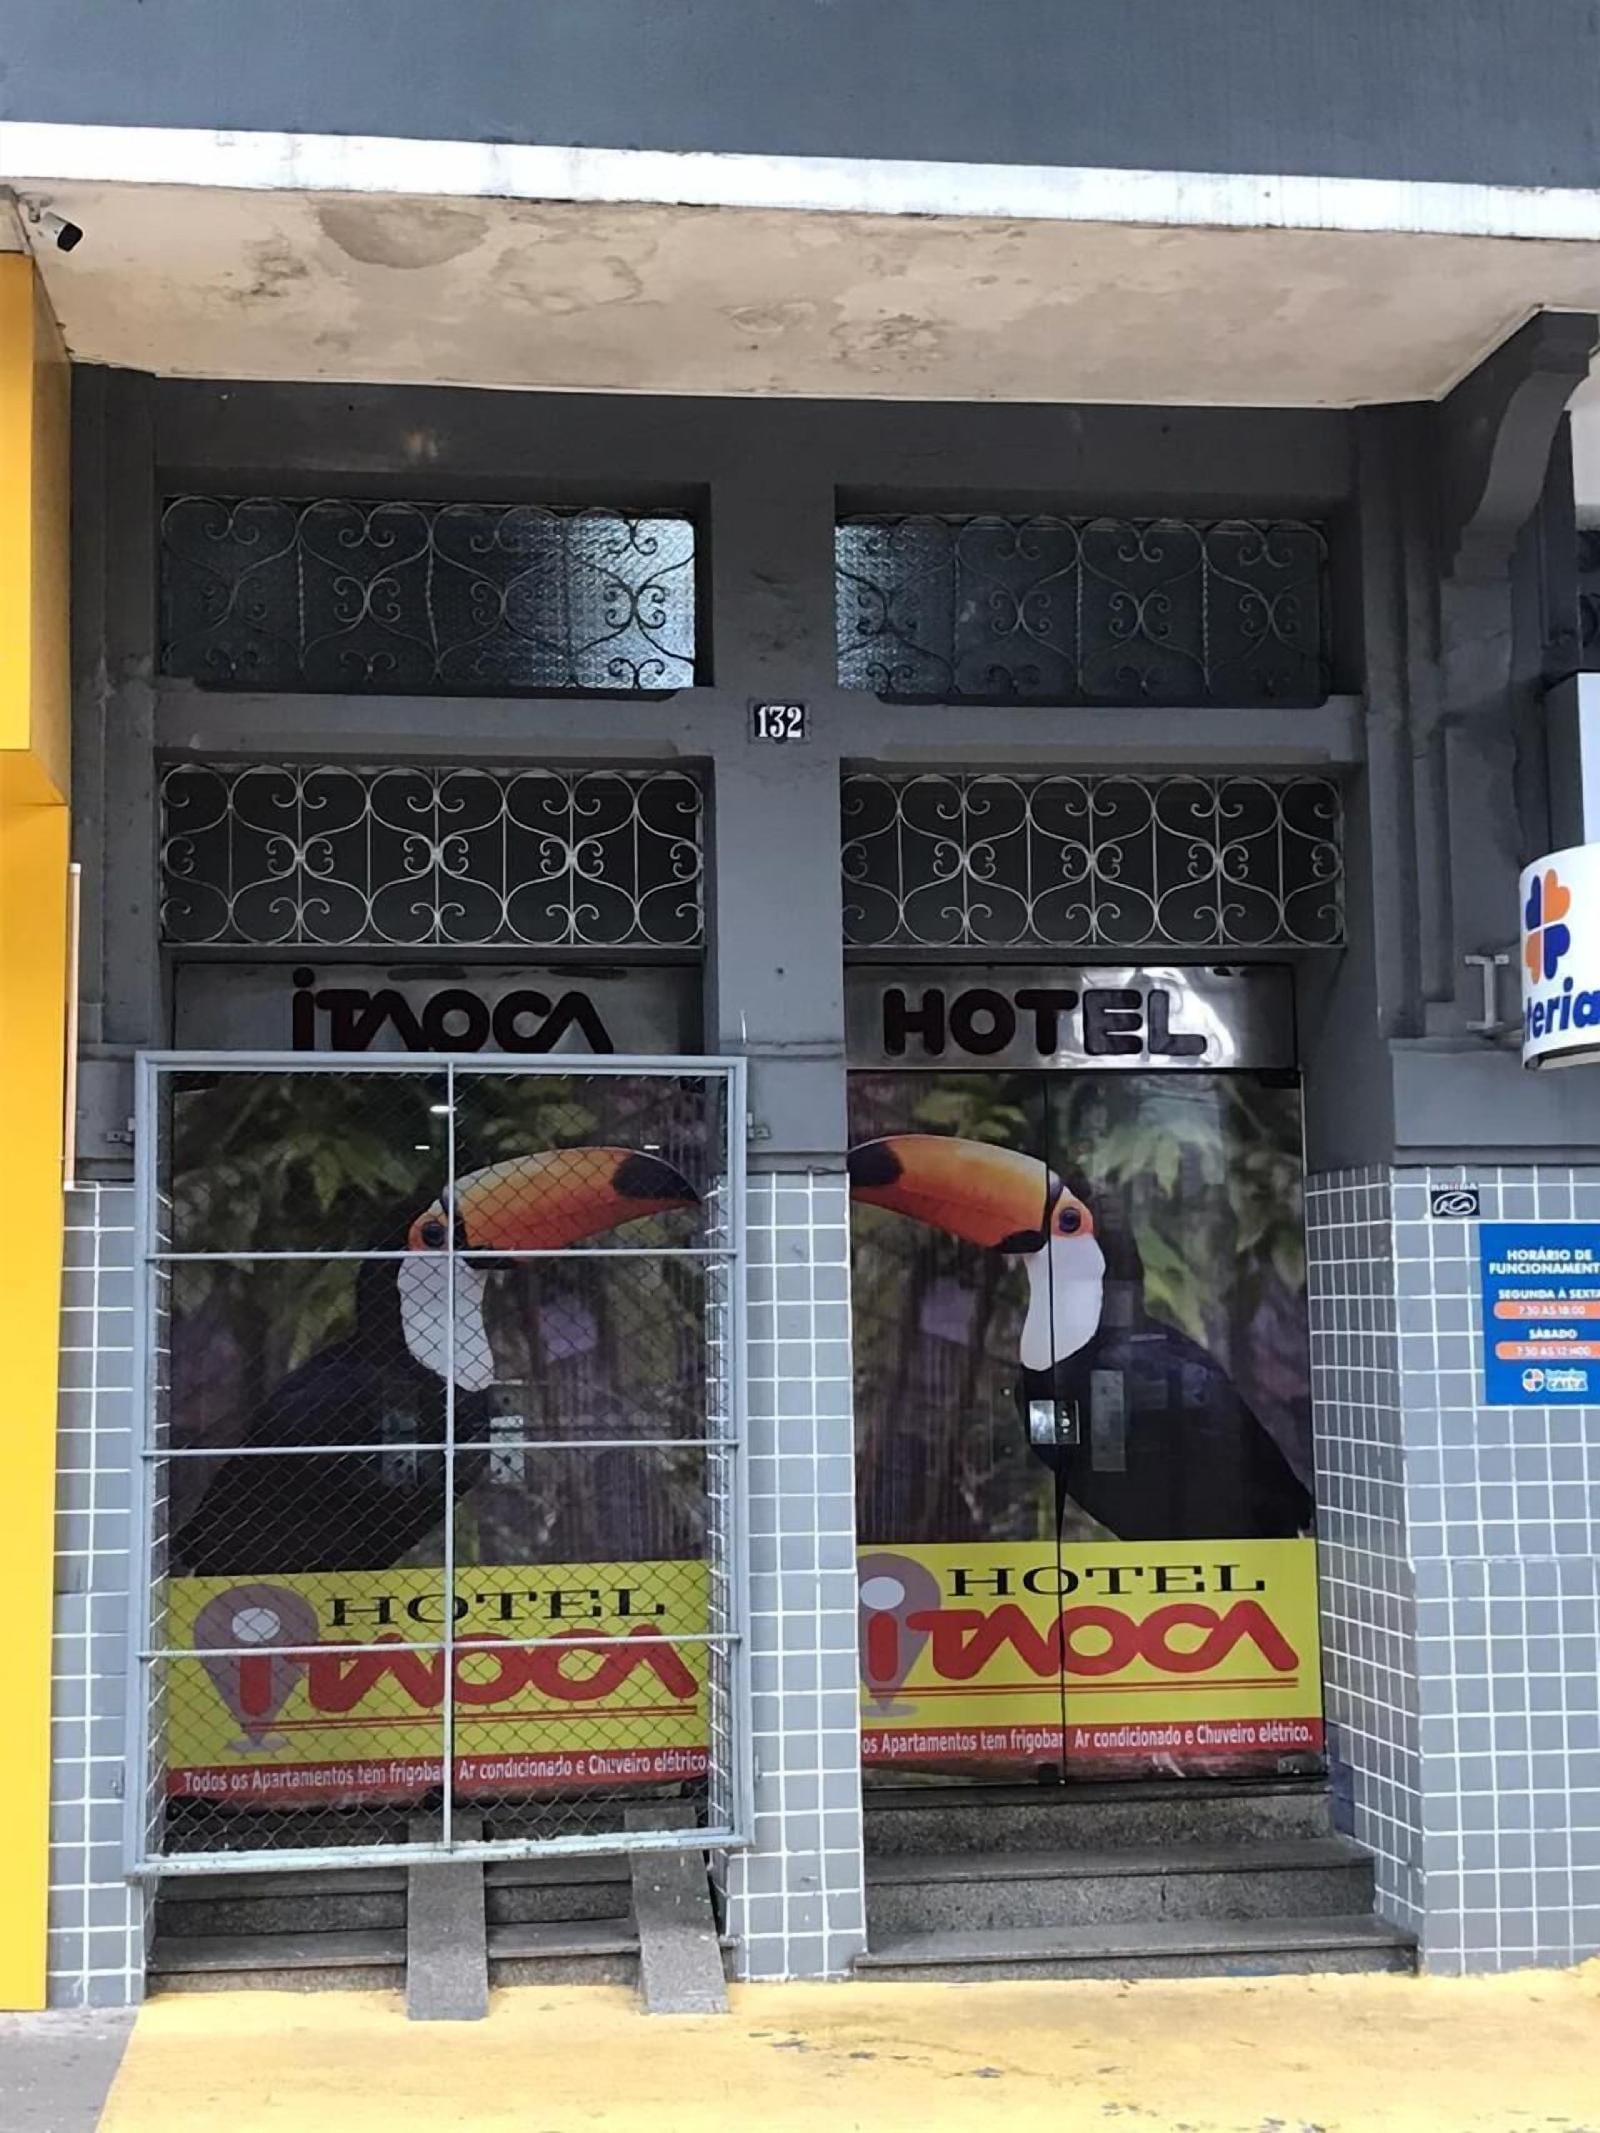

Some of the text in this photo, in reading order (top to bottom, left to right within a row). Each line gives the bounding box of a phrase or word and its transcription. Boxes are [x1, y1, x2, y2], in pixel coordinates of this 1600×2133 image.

[758, 705, 802, 738] 132
[883, 988, 1207, 1056] HOTEL
[1507, 1246, 1593, 1261] HORÁRIO DE
[1498, 1288, 1556, 1300] SEGUNDA
[1528, 1326, 1578, 1339] SÁBADO
[947, 1564, 1265, 1596] HOTEL
[326, 1587, 665, 1627] HOTEL
[864, 1739, 877, 1753] os
[881, 1733, 977, 1757] Apartamentos
[981, 1730, 1007, 1748] tem
[1074, 1730, 1090, 1749] Ar
[1093, 1728, 1181, 1748] condicionado
[1184, 1731, 1194, 1745] e
[1196, 1723, 1255, 1745] Chuveiro
[1259, 1720, 1313, 1743] elétrico.
[184, 1770, 227, 1792] Todos
[231, 1774, 248, 1790] os
[252, 1766, 354, 1789] Apartamentos
[358, 1764, 385, 1783] tem
[389, 1758, 444, 1787] frigoba
[458, 1759, 475, 1780] Ar
[479, 1755, 571, 1778] condicionado
[576, 1760, 584, 1774] e
[588, 1752, 650, 1775] Chuveiro
